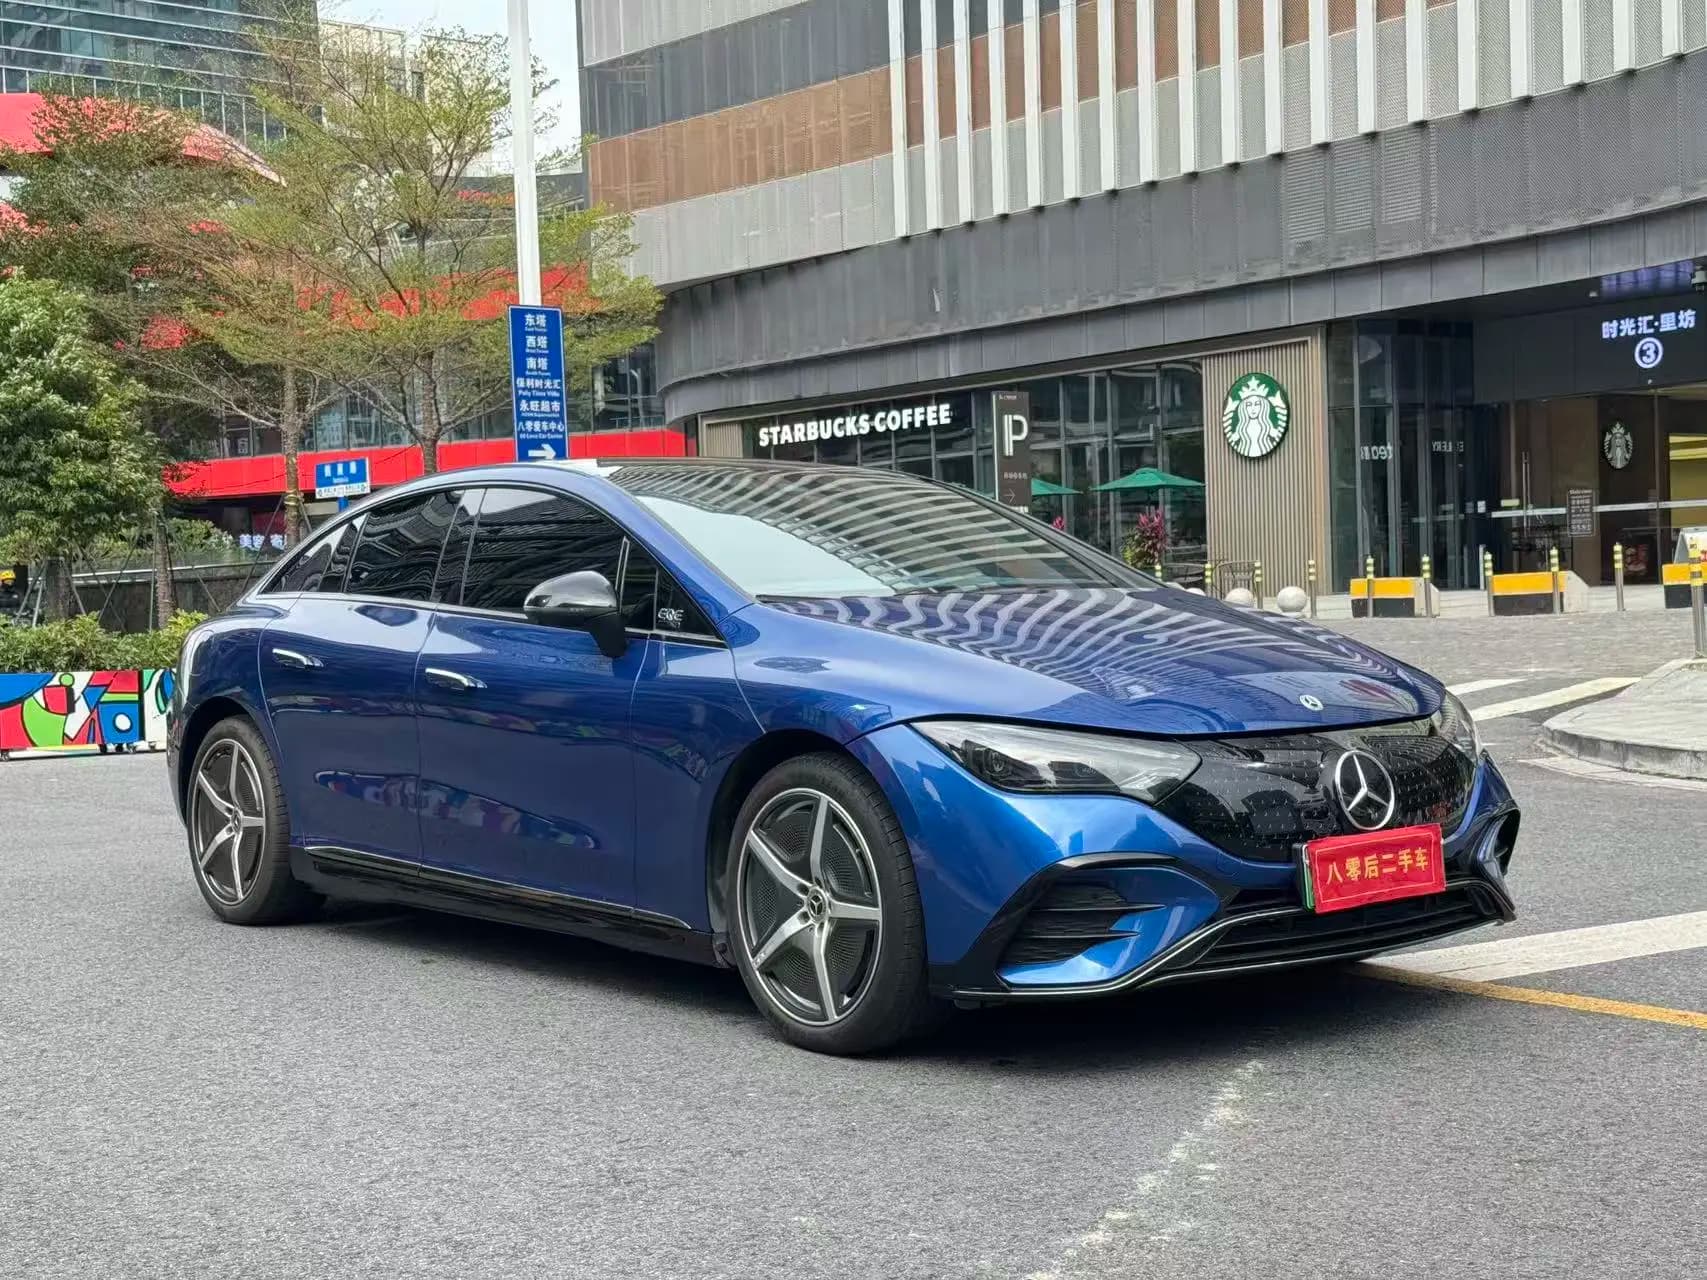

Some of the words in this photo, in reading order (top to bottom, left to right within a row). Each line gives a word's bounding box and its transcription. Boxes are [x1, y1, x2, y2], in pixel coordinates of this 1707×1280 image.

[525, 314, 546, 327] 东塔
[525, 335, 547, 349] 西塔
[526, 357, 548, 370] 南塔
[516, 377, 561, 389] 保利时光汇
[520, 399, 561, 412] 永旺超市
[517, 420, 565, 432] 八零爱车中心
[759, 414, 870, 447] STARBUCKS
[874, 403, 951, 431] COFFEE
[1003, 414, 1029, 456] P
[1326, 847, 1429, 885] 八零后二手车
